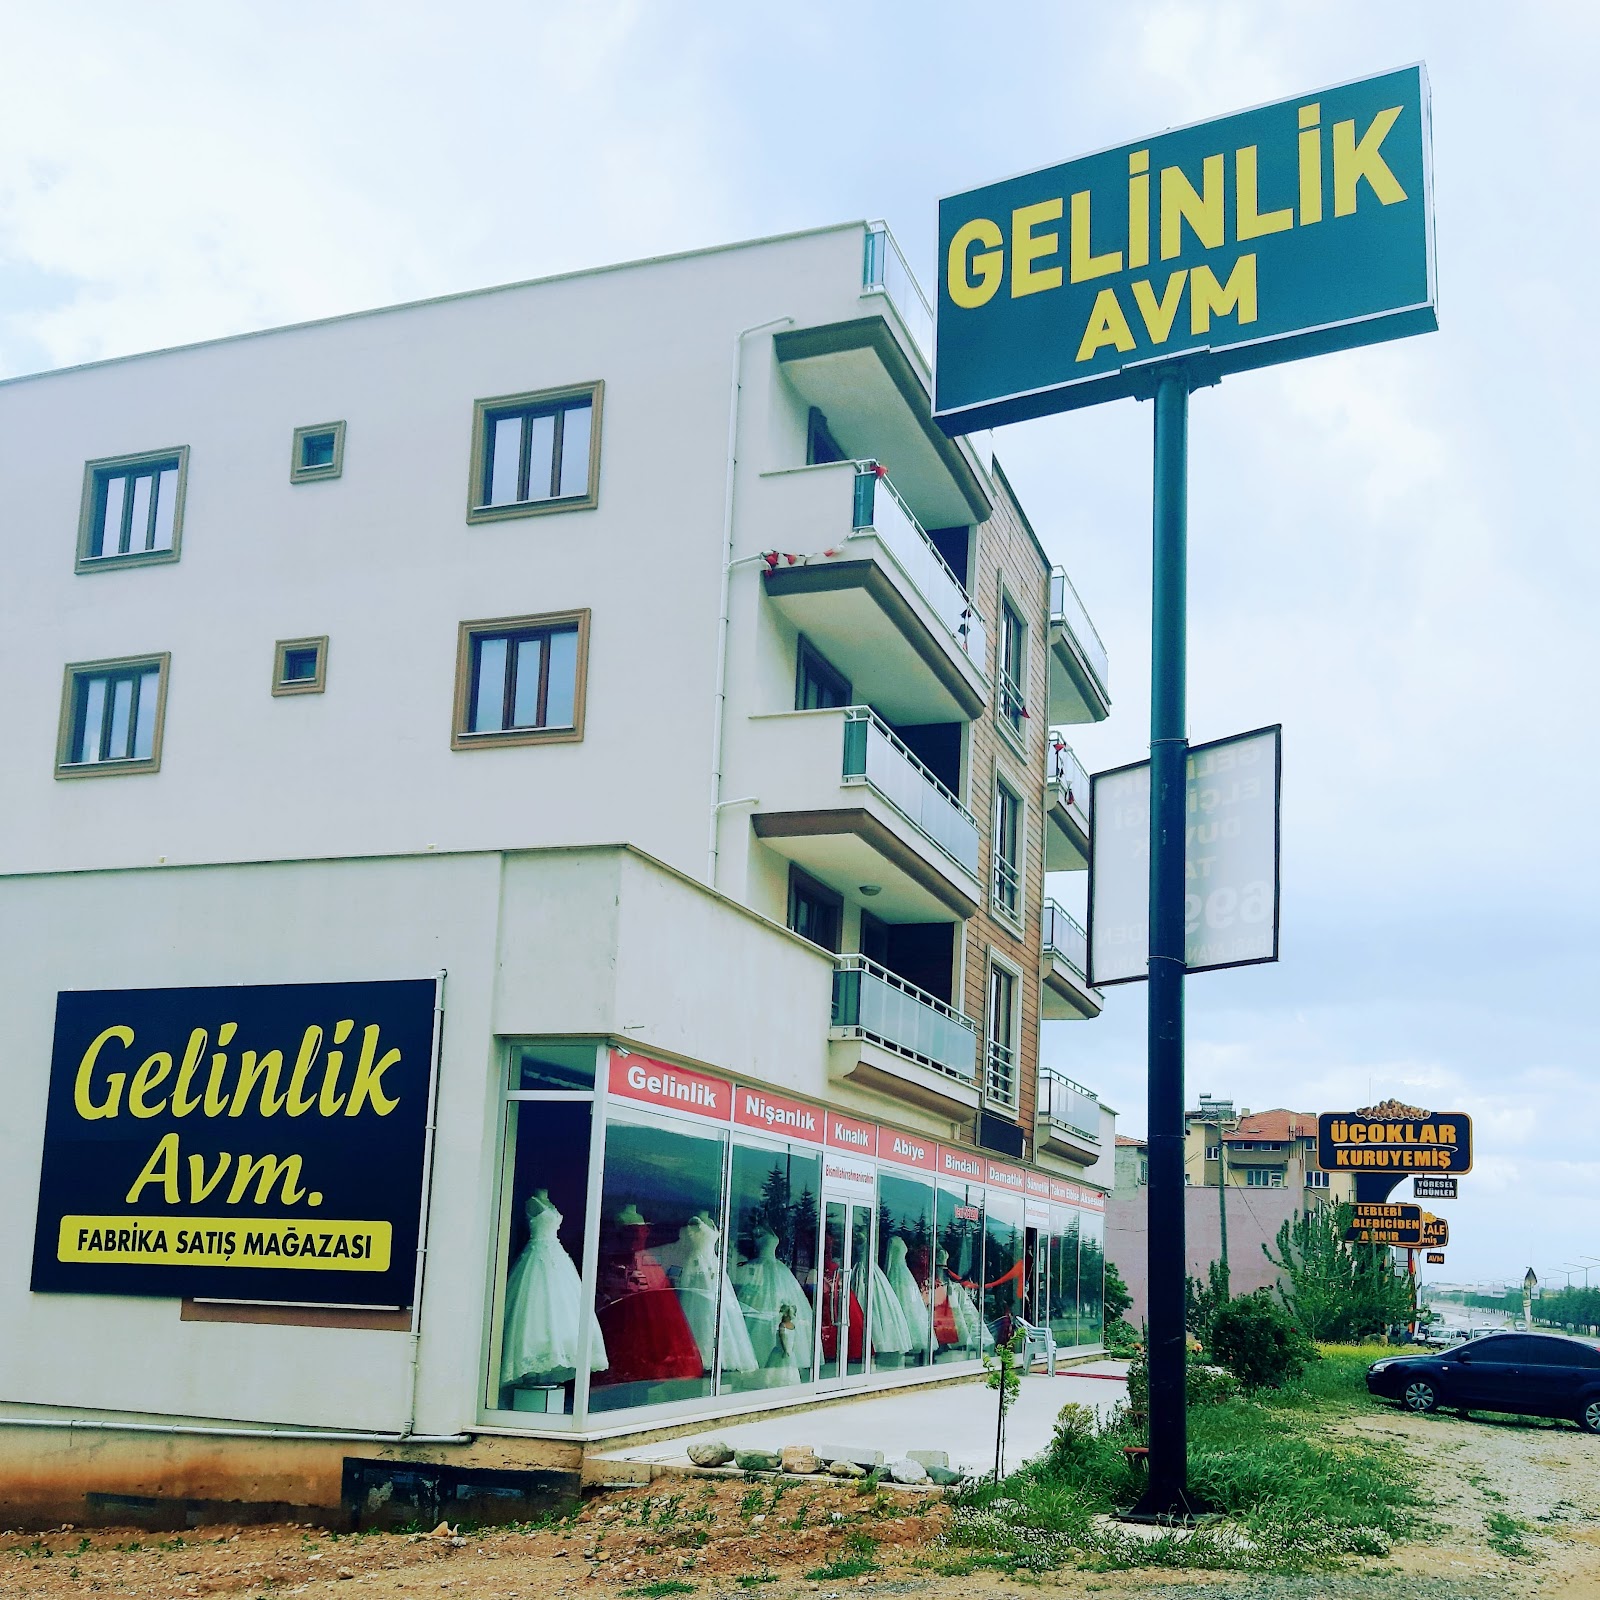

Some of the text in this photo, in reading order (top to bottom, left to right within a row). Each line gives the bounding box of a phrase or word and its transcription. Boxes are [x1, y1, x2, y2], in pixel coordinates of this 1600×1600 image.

[947, 102, 1409, 309] GELİNLİK
[1075, 253, 1258, 363] AVM
[74, 1018, 402, 1121] Gelinlik
[627, 1065, 718, 1109] Gelinlik
[745, 1094, 816, 1132] Nişanlık
[835, 1122, 869, 1147] Kınalık
[1331, 1120, 1457, 1145] ÜÇOKLAR
[893, 1137, 925, 1161] Abiye
[1336, 1148, 1451, 1169] KURUYEMİŞ
[125, 1132, 324, 1207] Avm.
[945, 1154, 980, 1176] Bindallı
[989, 1166, 1023, 1188] Damatlık
[1418, 1180, 1454, 1188] YÖRESEL
[1350, 1217, 1420, 1230] BLEBİCİDEN
[1357, 1205, 1402, 1217] LEBLEBİ
[77, 1222, 373, 1261] FABRİKA SATIŞ MAĞAZASI
